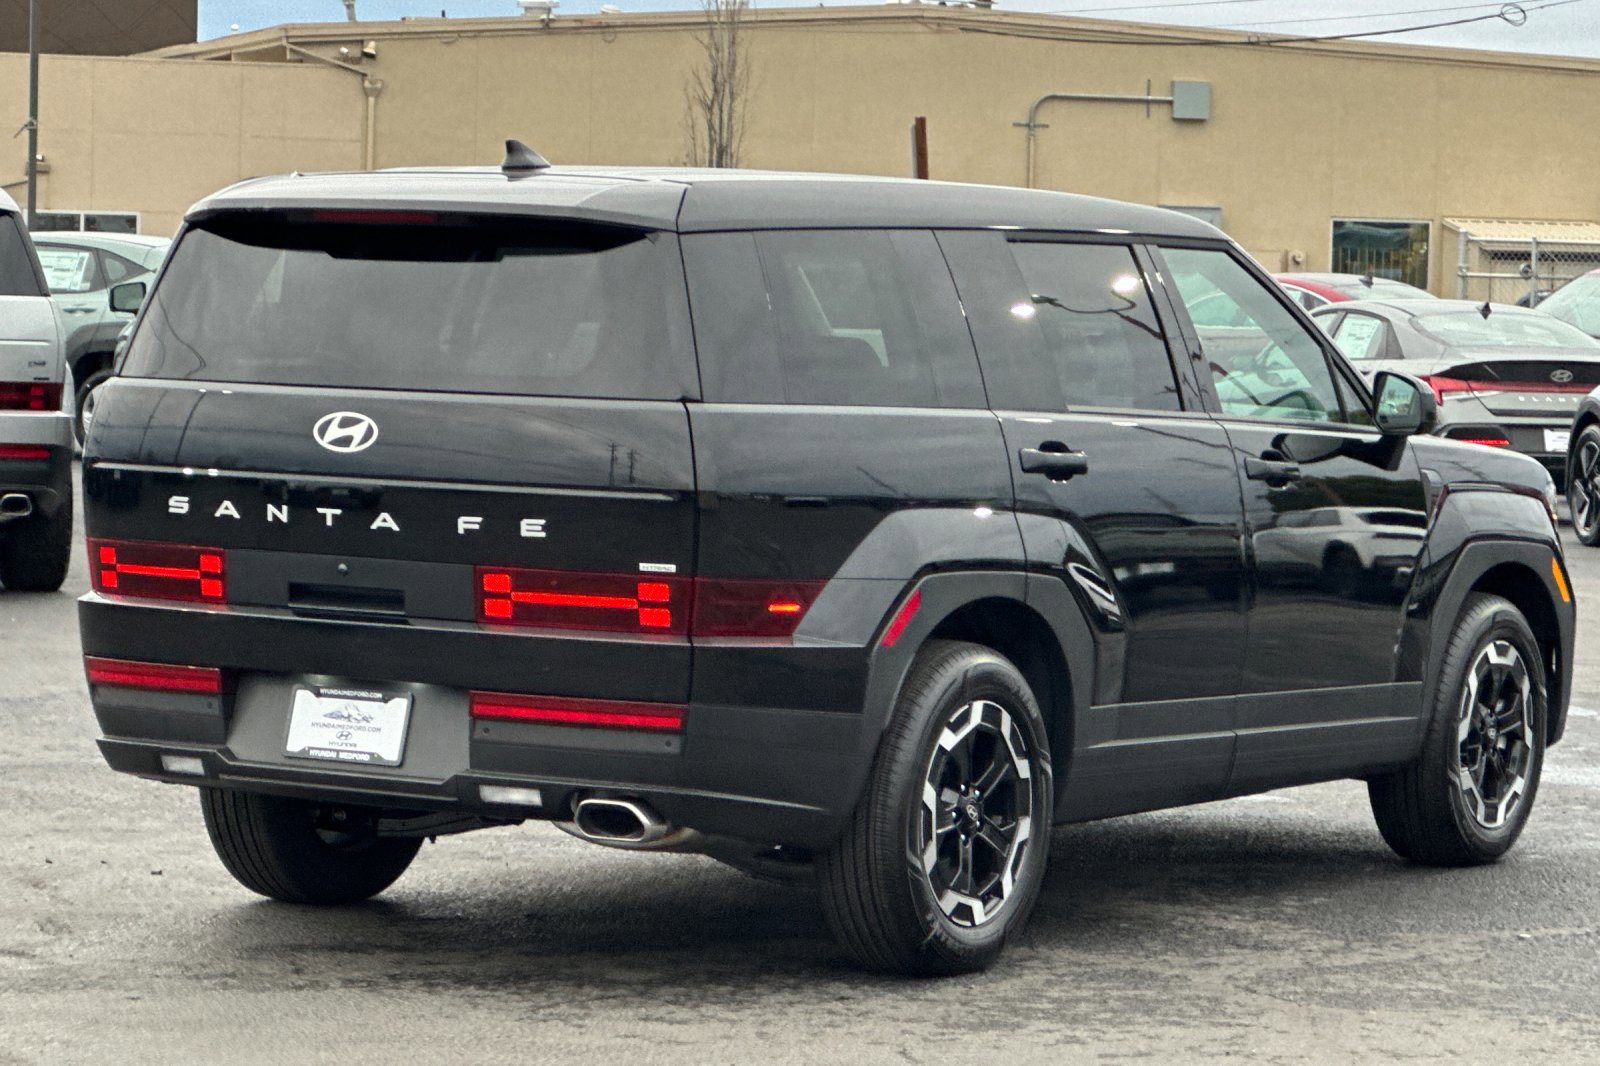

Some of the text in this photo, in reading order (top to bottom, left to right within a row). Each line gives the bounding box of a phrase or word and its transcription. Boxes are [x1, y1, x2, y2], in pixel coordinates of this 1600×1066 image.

[167, 495, 547, 538] SANTA FE
[319, 688, 383, 698] HYUNDAIMEDFORD.COM
[311, 721, 382, 733] HYUNDAIMEDFORD.COM
